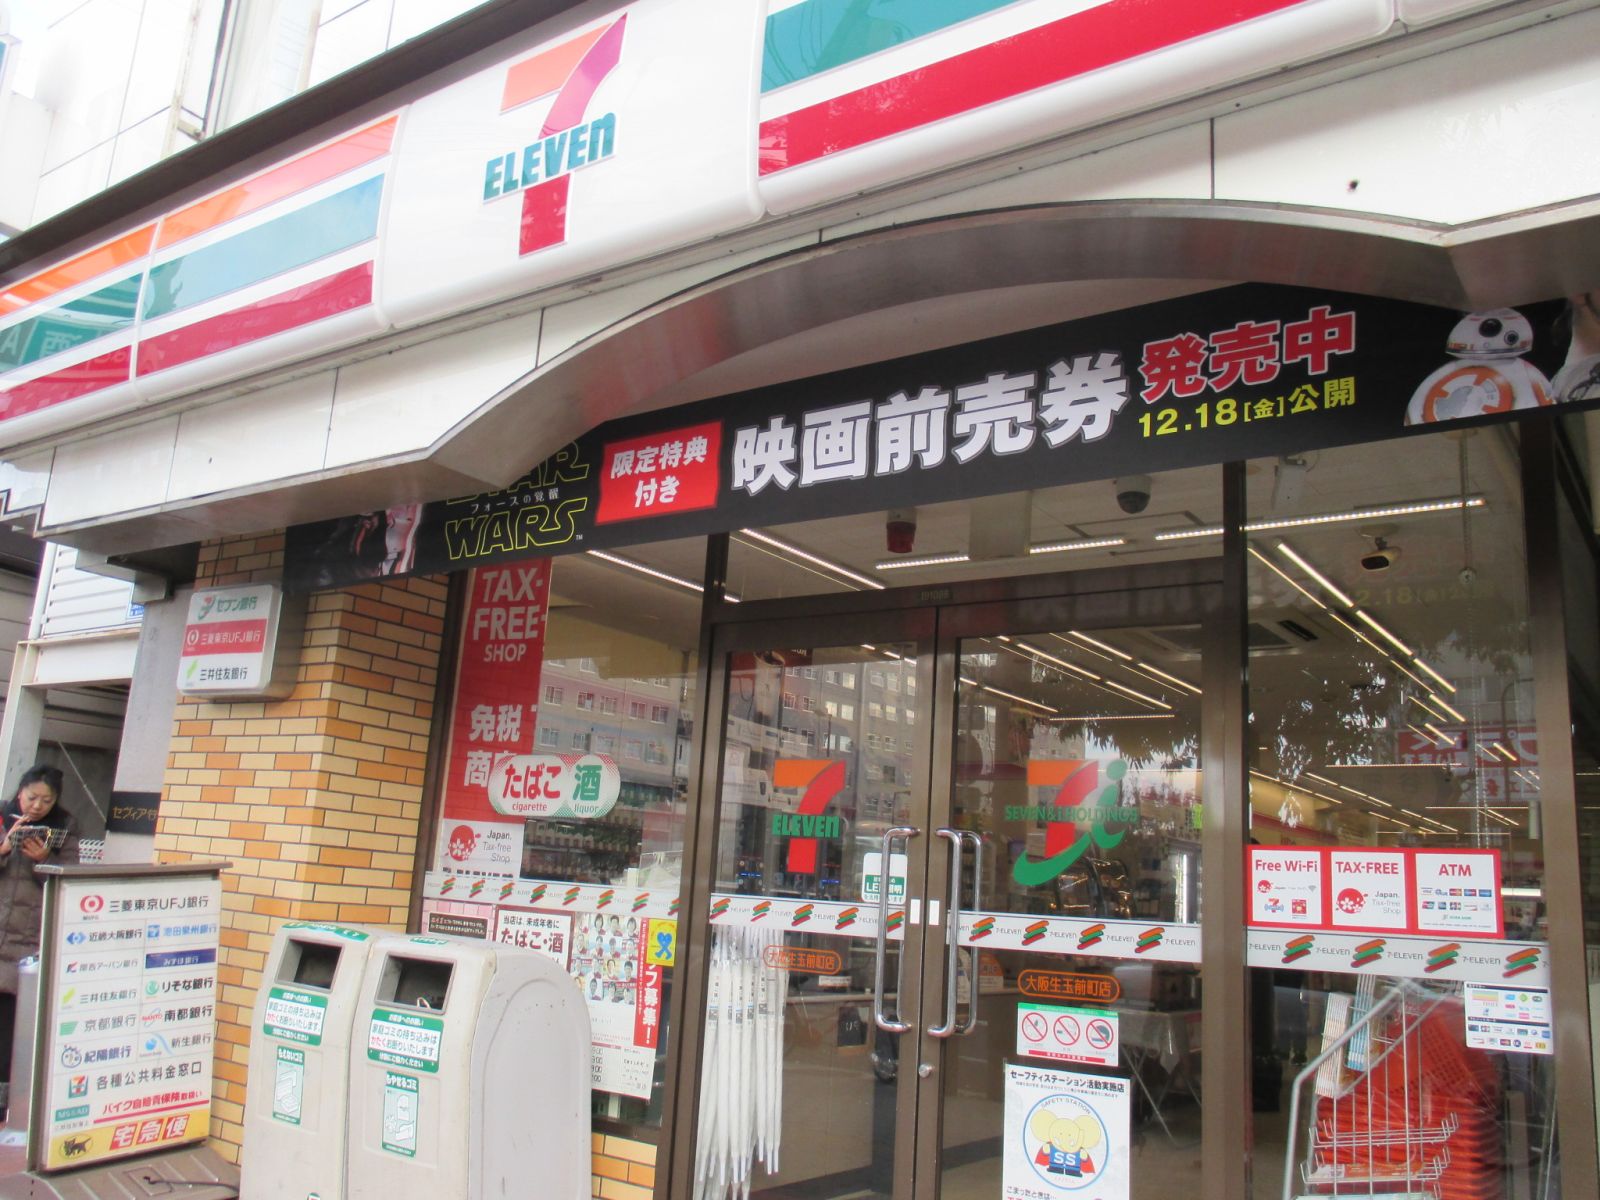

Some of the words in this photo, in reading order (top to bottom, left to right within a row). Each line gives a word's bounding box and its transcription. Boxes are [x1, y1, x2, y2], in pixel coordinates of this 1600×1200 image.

[1138, 305, 1356, 404] 発売中
[732, 352, 1130, 496] 映画前売券
[610, 435, 708, 480] 限定特典
[471, 487, 559, 514] フォースの覚醒
[634, 475, 681, 508] 付き
[445, 497, 588, 560] WARS
[472, 604, 539, 641] FREE
[200, 629, 261, 646] 三菱東京UFJ銀行
[483, 643, 527, 663] SHOP
[199, 666, 248, 681] 三井住友銀行
[468, 703, 523, 743] 免税
[502, 763, 562, 800] たばこ
[572, 764, 603, 802] 酒
[512, 801, 548, 813] cigarette
[573, 802, 600, 814] liquor
[491, 853, 511, 865] Shop
[1255, 859, 1282, 872] Free
[1284, 860, 1318, 873] Wi-Fi
[1335, 861, 1400, 875] TAX-FREE
[1438, 863, 1472, 877] ATM
[108, 895, 209, 913] 三菱東京UFJ銀行
[161, 976, 214, 993] りそな銀行
[1025, 974, 1113, 998] 大阪生玉前町店
[79, 988, 137, 1004] 三井住友銀行
[83, 1013, 137, 1033] 京都銀行
[164, 1004, 213, 1022] 南都銀行
[171, 1032, 212, 1049] 新生銀行
[83, 1045, 132, 1065] 紀陽銀行
[96, 1061, 202, 1091] 各種公共料金窓口
[1010, 1069, 1125, 1093] セーフティステーション活動実施店
[112, 1114, 188, 1148] 宅急便
[1053, 1151, 1076, 1166] SS
